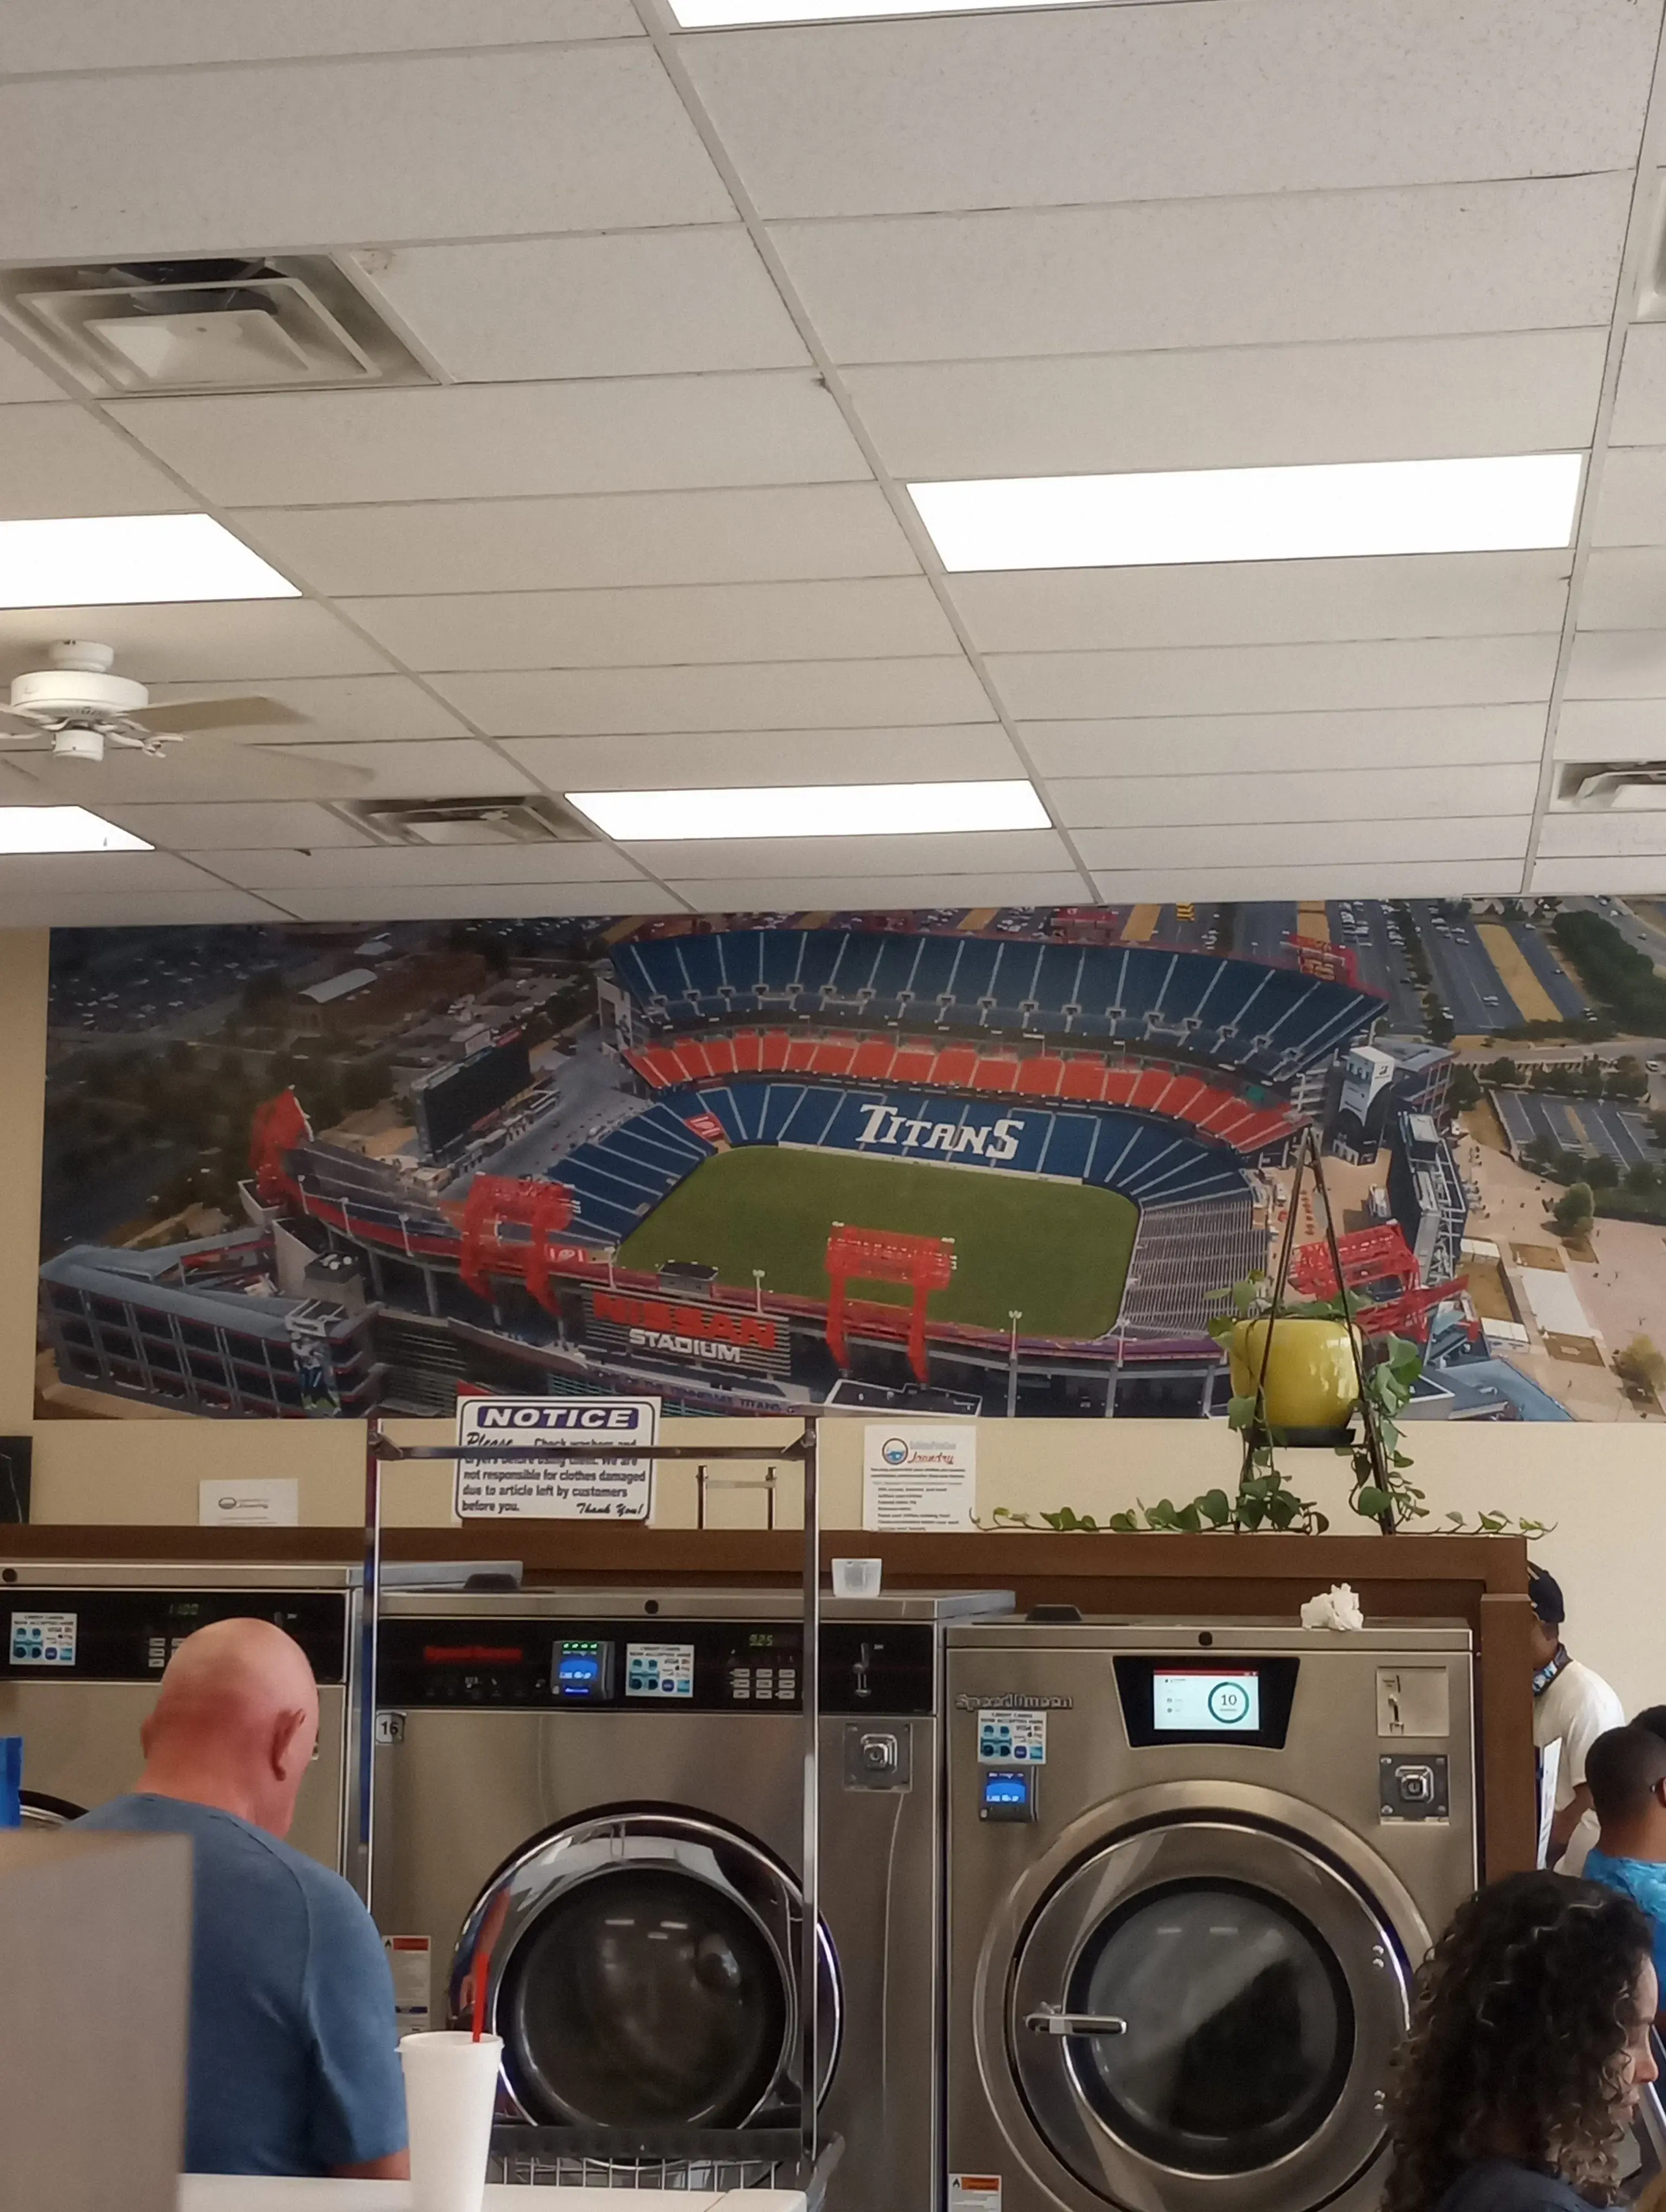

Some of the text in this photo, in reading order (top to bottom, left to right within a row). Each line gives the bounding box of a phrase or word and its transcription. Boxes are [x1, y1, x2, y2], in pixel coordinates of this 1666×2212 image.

[855, 1103, 1025, 1160] TITANS
[592, 1291, 776, 1349] NISSAN
[629, 1328, 741, 1363] STADIUM
[482, 1408, 633, 1428] NOTICE
[464, 1469, 646, 1485] not responsible for clothes damaged
[463, 1484, 628, 1499] due to article left by customers
[462, 1500, 496, 1512] before
[576, 1502, 611, 1514] Thank
[616, 1503, 644, 1517] You!
[1221, 1694, 1238, 1706] 10
[380, 1720, 399, 1736] 16
